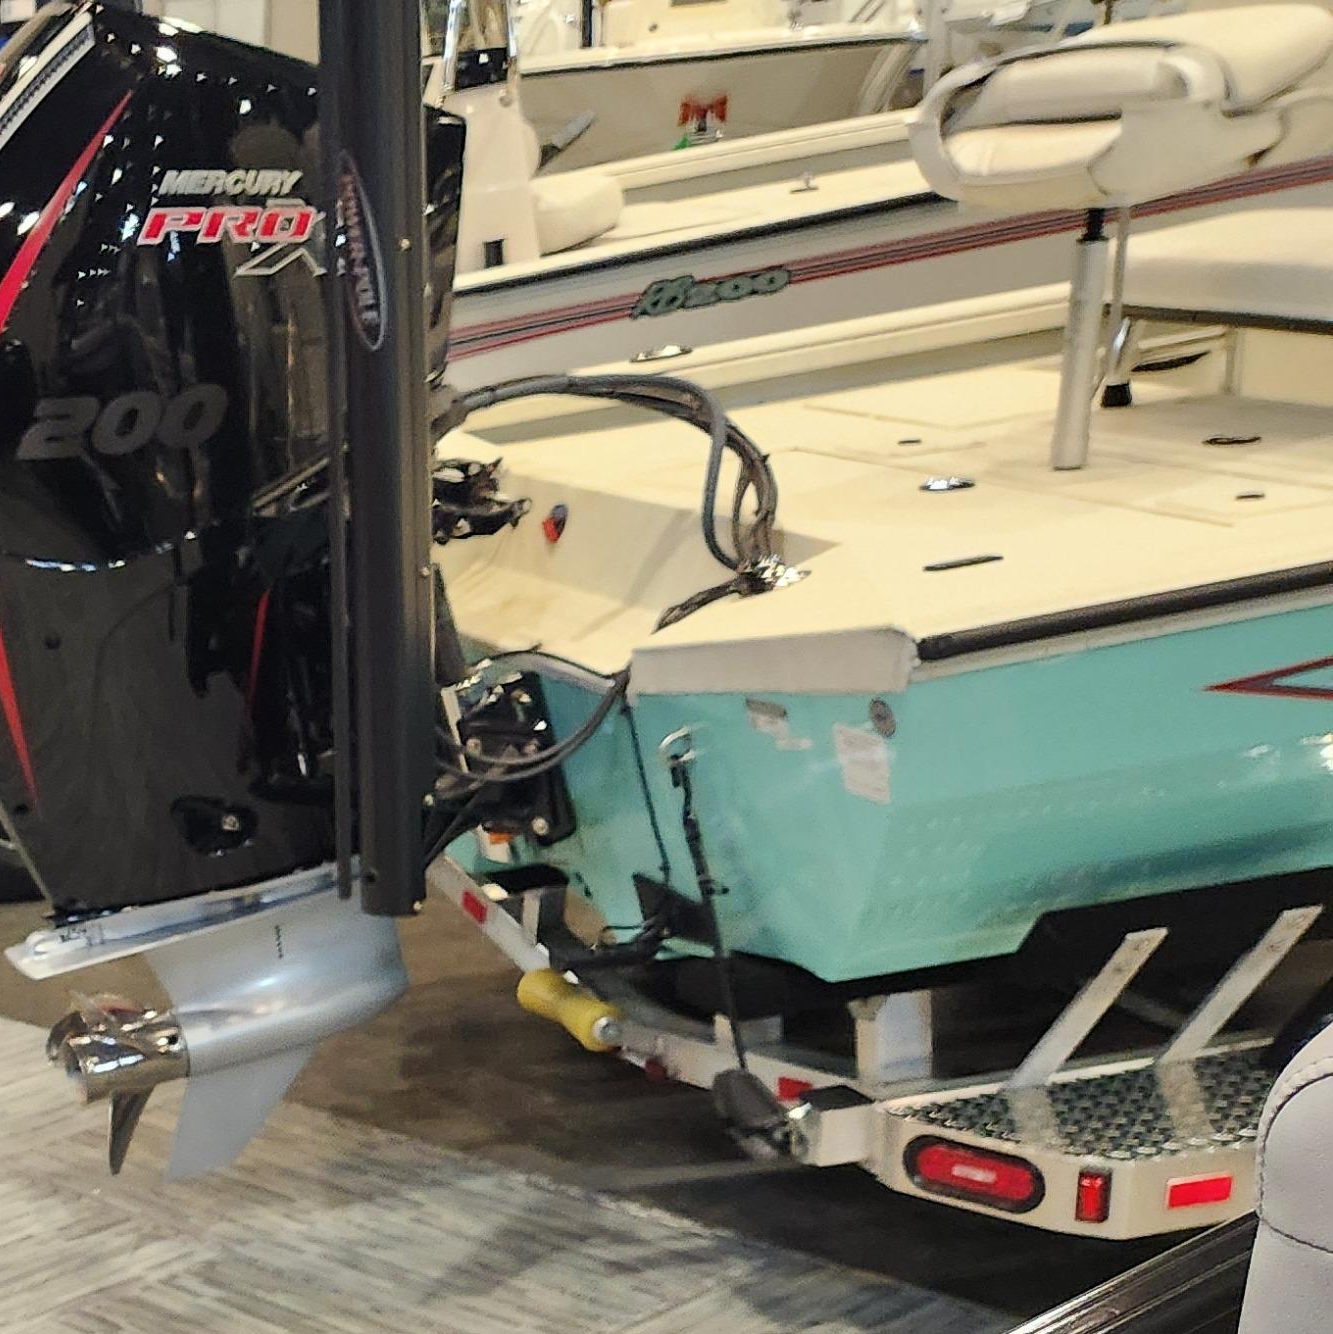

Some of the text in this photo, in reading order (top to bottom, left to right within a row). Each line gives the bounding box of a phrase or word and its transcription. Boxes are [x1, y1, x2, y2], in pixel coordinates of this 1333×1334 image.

[158, 169, 304, 196] MERCURY
[137, 206, 318, 246] PRO
[17, 384, 229, 459] 200
